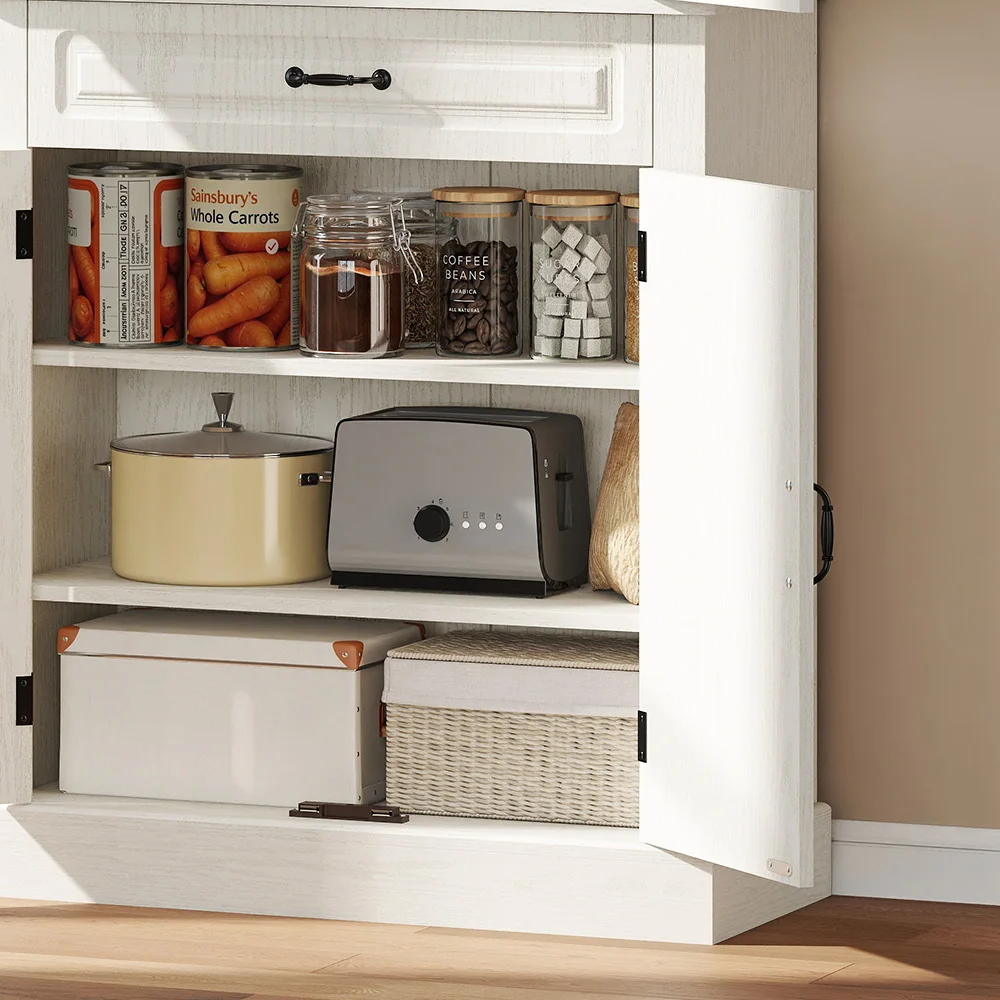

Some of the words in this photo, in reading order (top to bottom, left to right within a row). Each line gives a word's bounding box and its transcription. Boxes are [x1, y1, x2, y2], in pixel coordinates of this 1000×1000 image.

[190, 188, 258, 208] Sainsbury's
[190, 207, 224, 224] Whole
[228, 210, 280, 225] Carrots
[442, 254, 489, 266] COFFEE
[445, 269, 486, 281] BEANS
